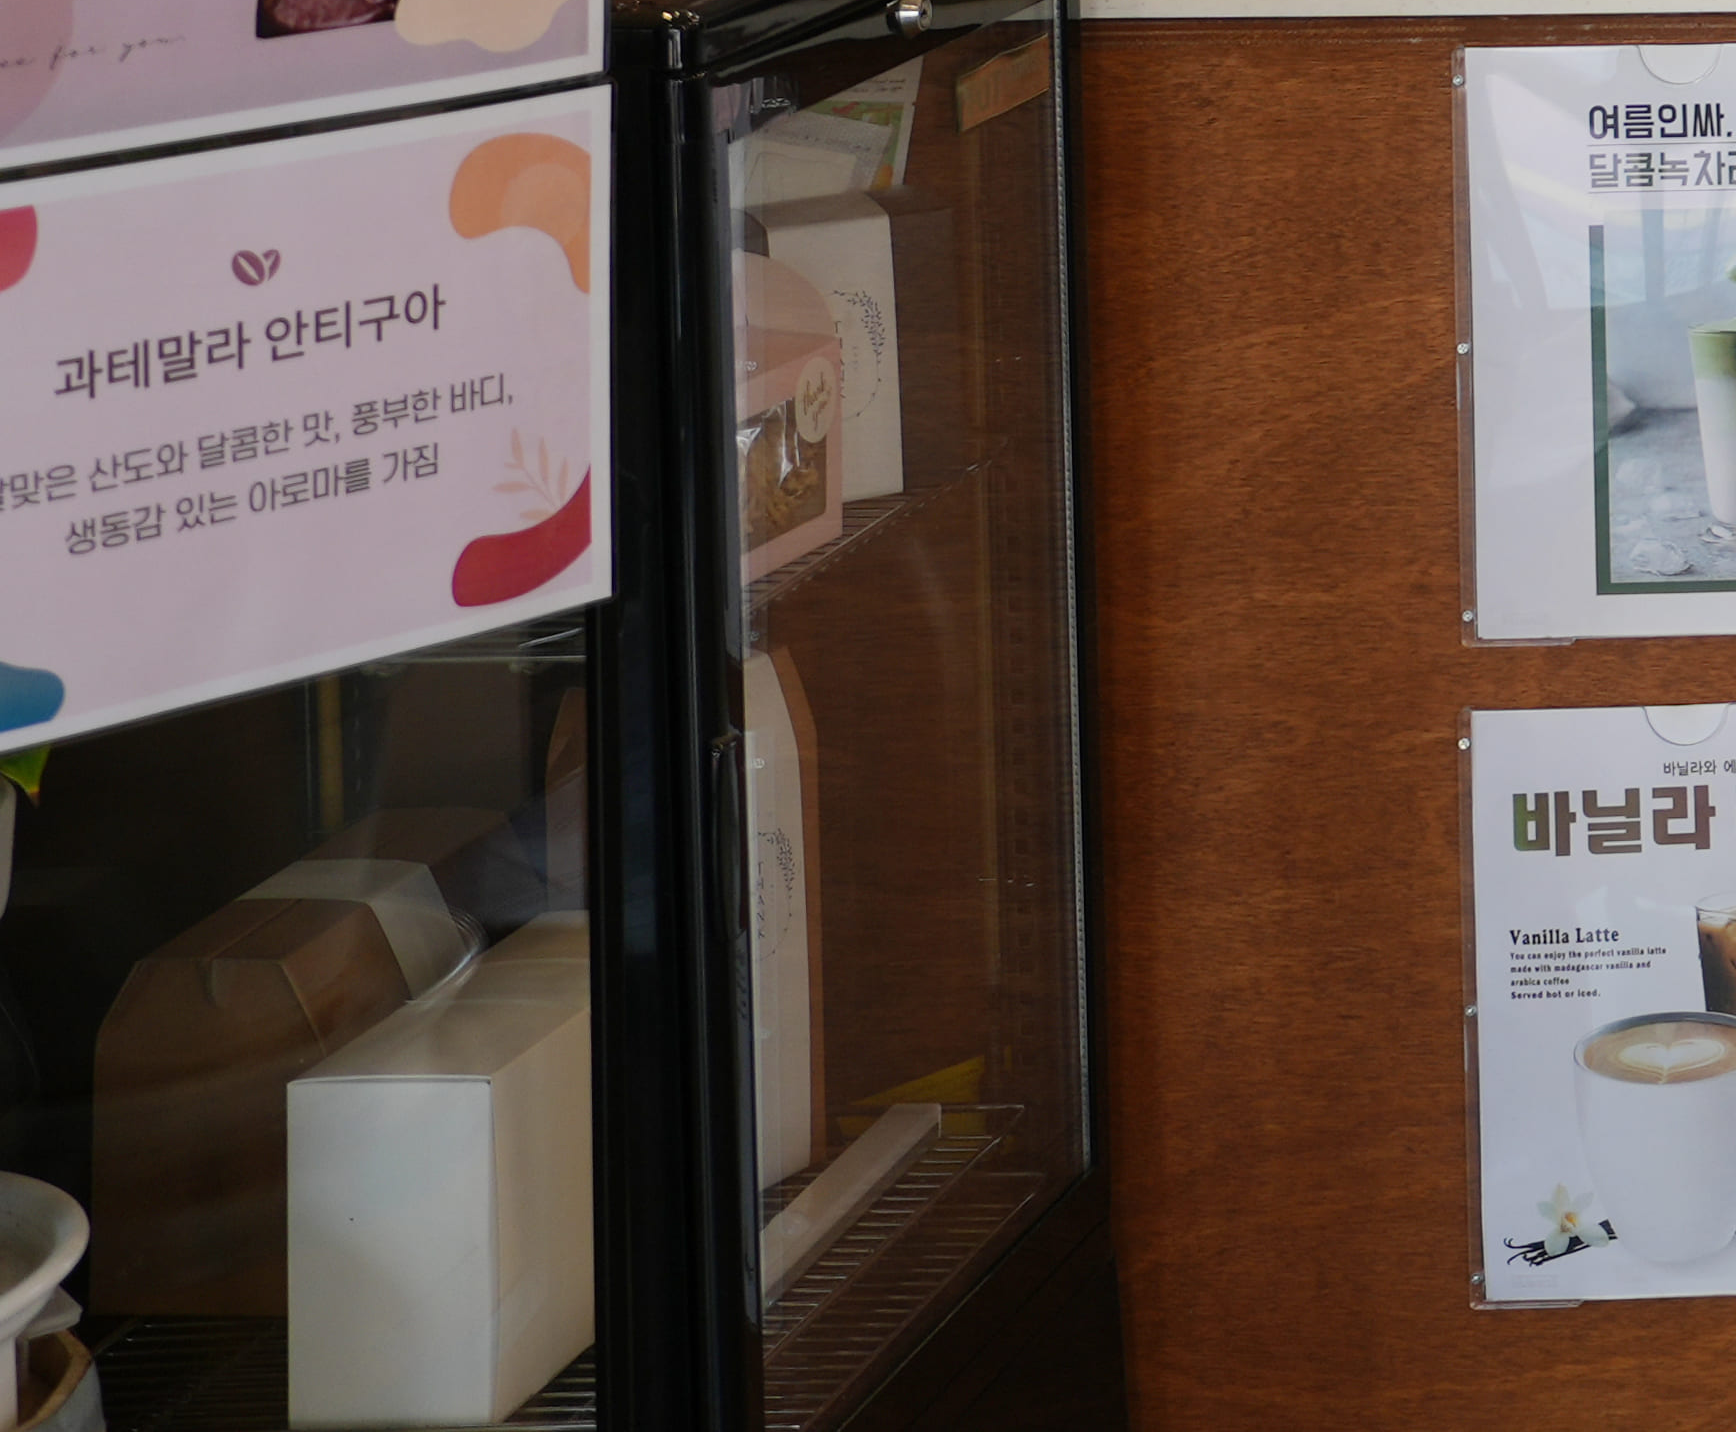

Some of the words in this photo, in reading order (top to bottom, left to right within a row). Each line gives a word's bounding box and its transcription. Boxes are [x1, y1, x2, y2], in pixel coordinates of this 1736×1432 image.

[54, 320, 251, 400] 과테말라
[264, 283, 446, 363] 안티구아
[1511, 784, 1716, 858] 바닐라
[1509, 929, 1569, 945] Vanilla
[1576, 928, 1620, 943] Latte
